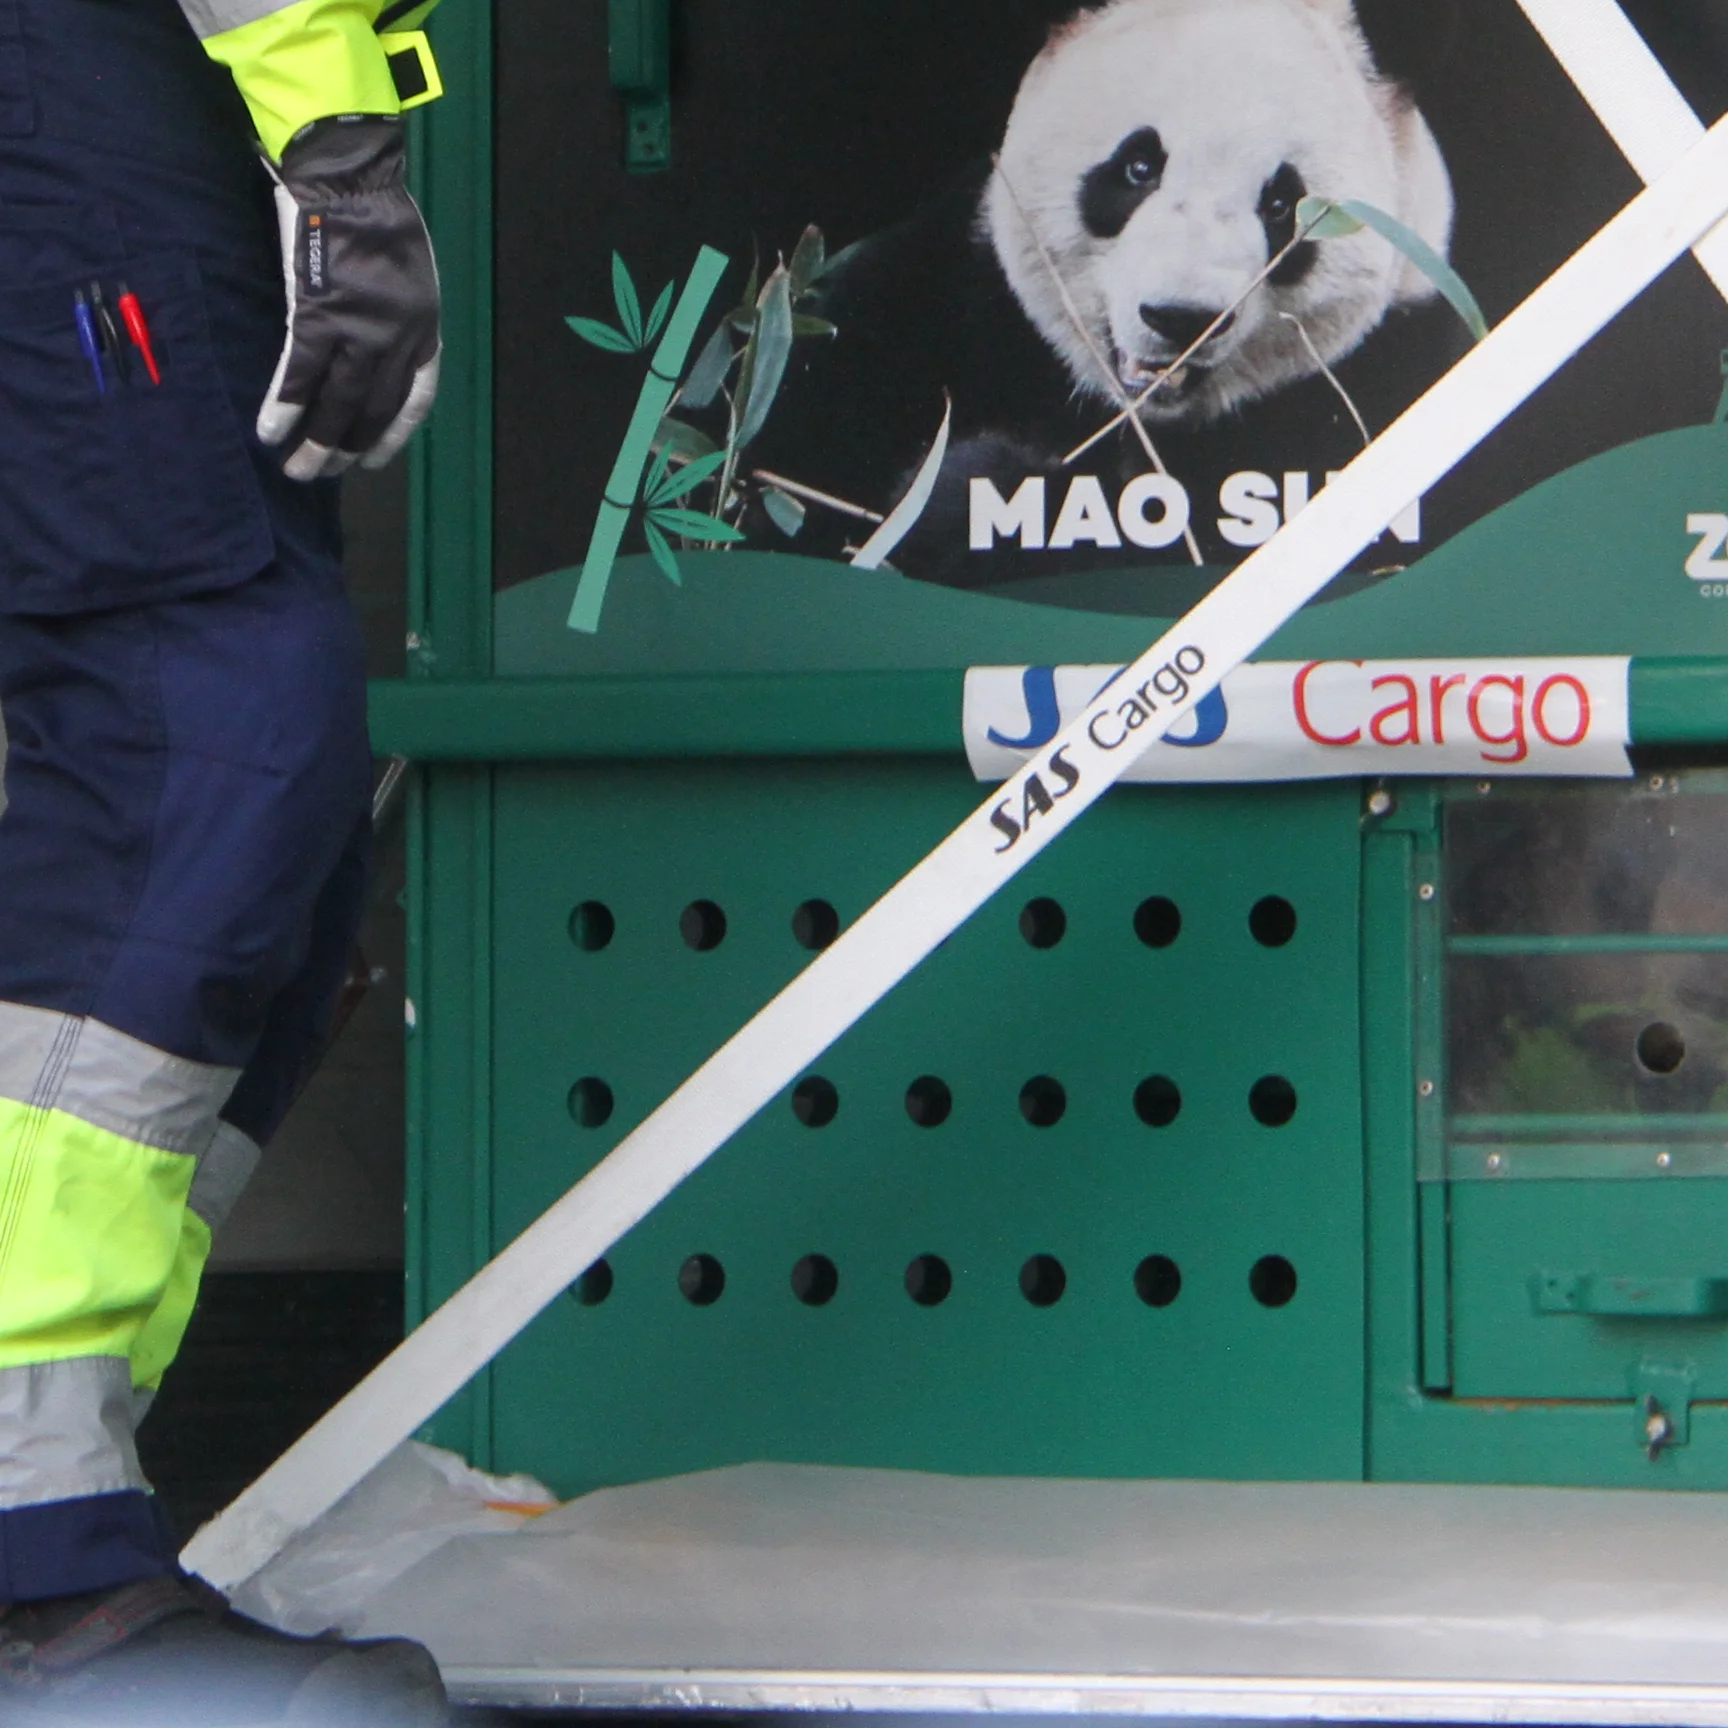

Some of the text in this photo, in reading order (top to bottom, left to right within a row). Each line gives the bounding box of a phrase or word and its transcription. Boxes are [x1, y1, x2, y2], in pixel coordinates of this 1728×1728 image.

[969, 471, 1191, 550] MAO
[989, 645, 1205, 854] SAS Cargo
[1291, 660, 1592, 763] Cargo
